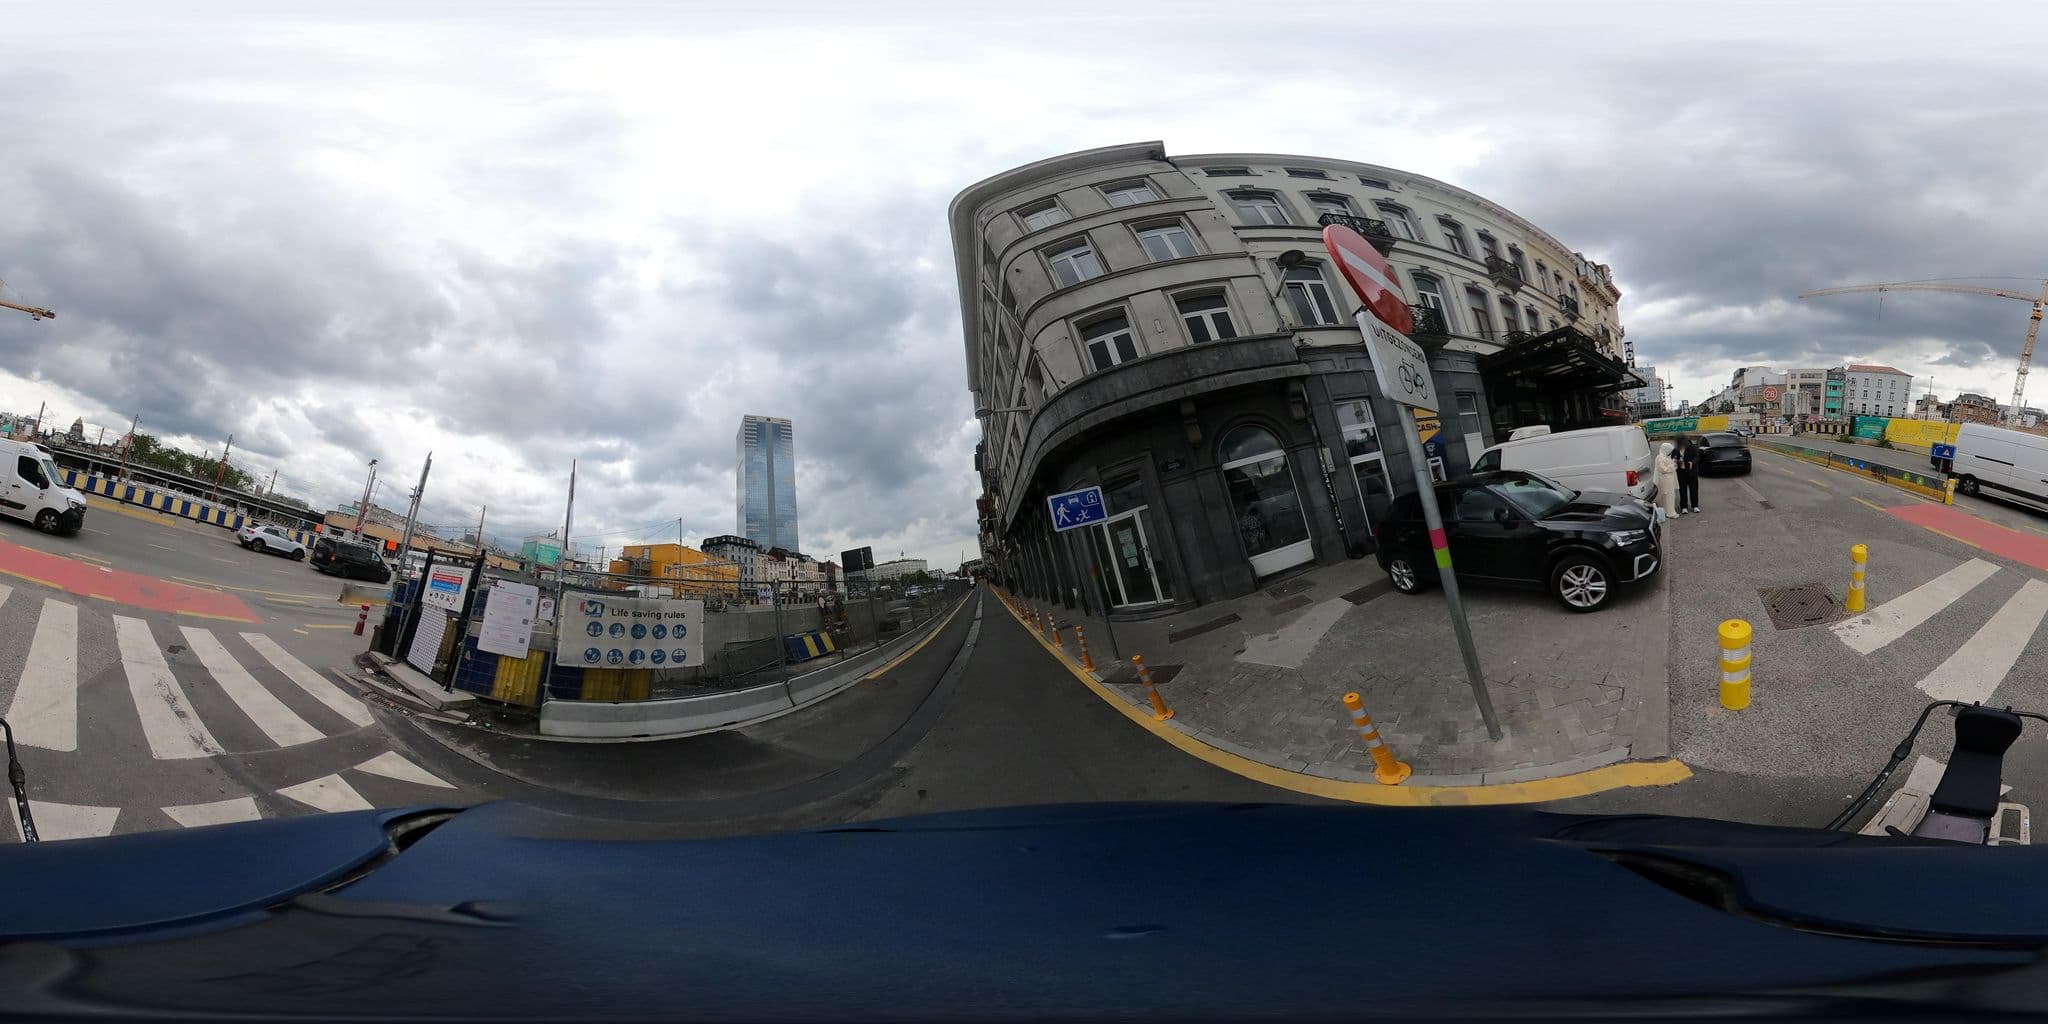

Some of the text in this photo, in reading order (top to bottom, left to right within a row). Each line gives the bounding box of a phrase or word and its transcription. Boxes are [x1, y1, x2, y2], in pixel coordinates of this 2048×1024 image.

[611, 608, 686, 620] Life saving rules
